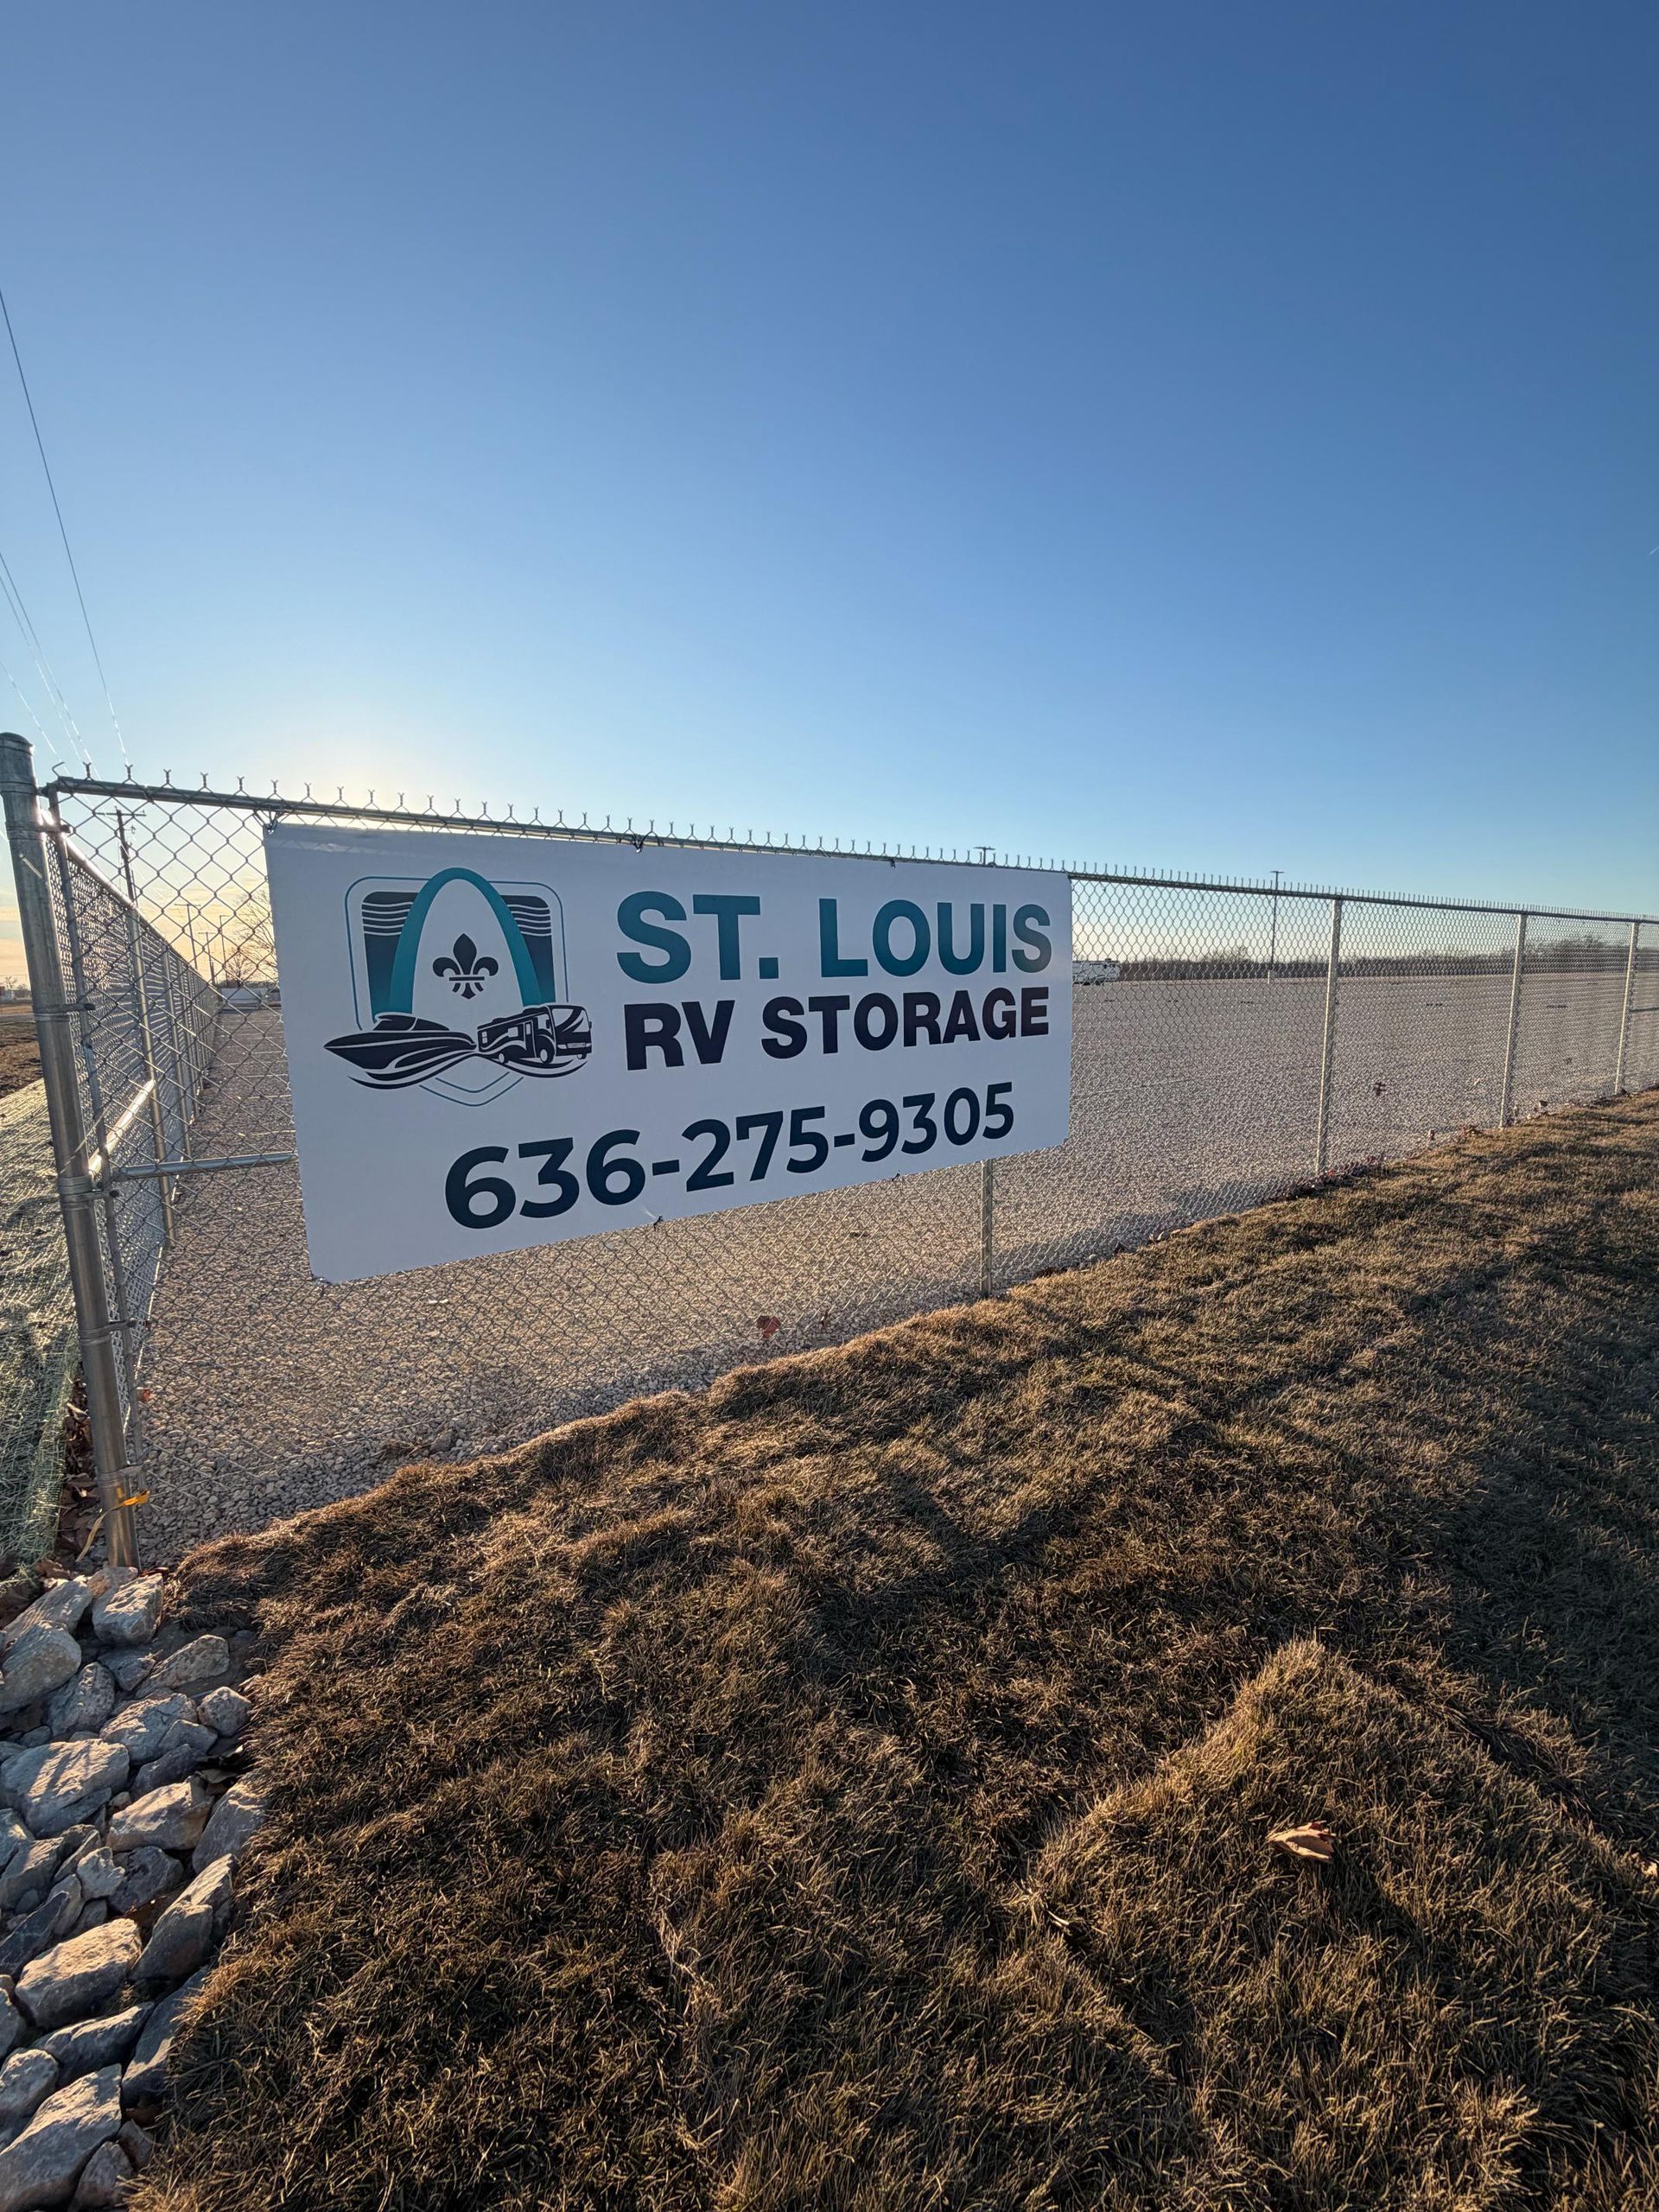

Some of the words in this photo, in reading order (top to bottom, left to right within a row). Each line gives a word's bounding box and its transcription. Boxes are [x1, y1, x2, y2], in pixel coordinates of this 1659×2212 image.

[616, 890, 779, 984] ST.
[819, 897, 1052, 981] LOUIS
[624, 999, 735, 1071] RV
[760, 986, 1050, 1058] STORAGE
[444, 1081, 1015, 1230] 636-275-9305
